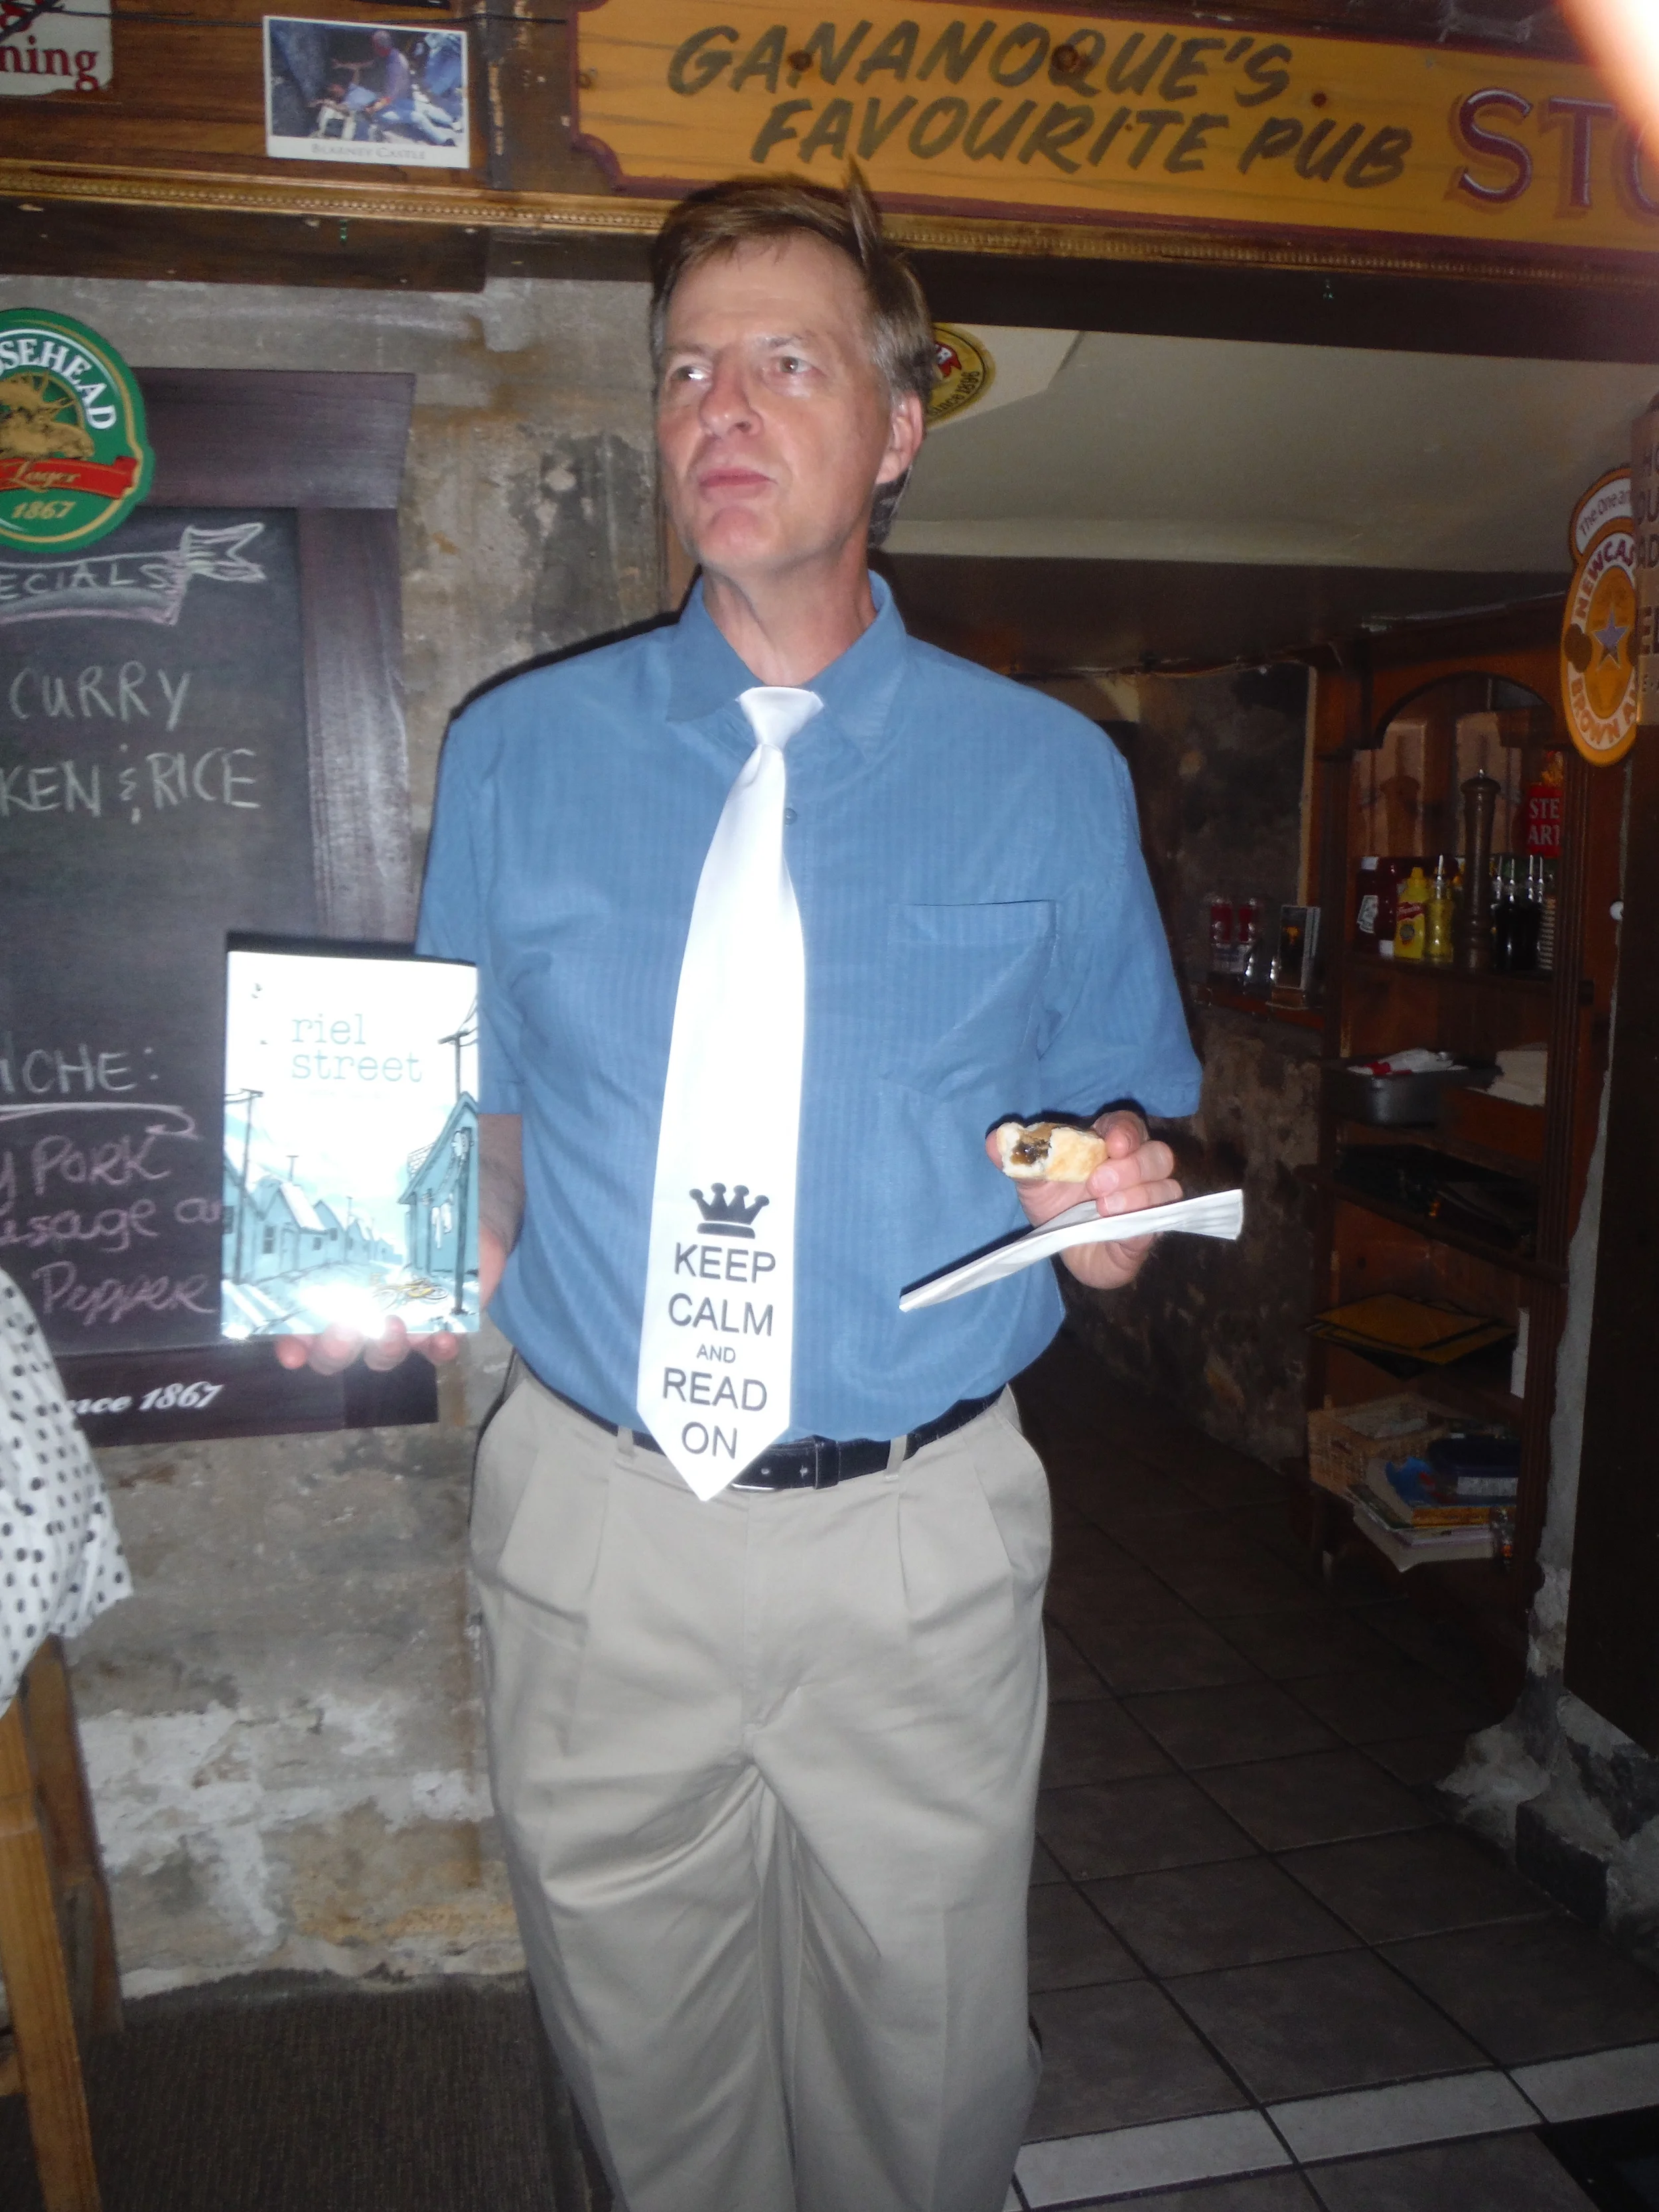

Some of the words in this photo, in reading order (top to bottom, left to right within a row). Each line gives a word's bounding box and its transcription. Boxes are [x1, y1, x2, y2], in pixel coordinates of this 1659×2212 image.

[667, 19, 1293, 108] GANANOQUE'S
[750, 95, 1229, 174] FAVOURITE
[1237, 117, 1413, 189] PUB
[0, 338, 117, 430] SEHEAD
[12, 500, 76, 520] 1867
[9, 660, 192, 731] CURRY
[0, 759, 102, 818] KEN
[146, 747, 261, 810] RICE
[291, 1013, 366, 1045] riel
[291, 1049, 423, 1083] street
[674, 1242, 776, 1284] KEEP
[668, 1293, 773, 1336] CALM
[696, 1343, 736, 1363] AND
[139, 1380, 224, 1412] 1867
[663, 1366, 767, 1412] READ
[682, 1421, 737, 1459] ON
